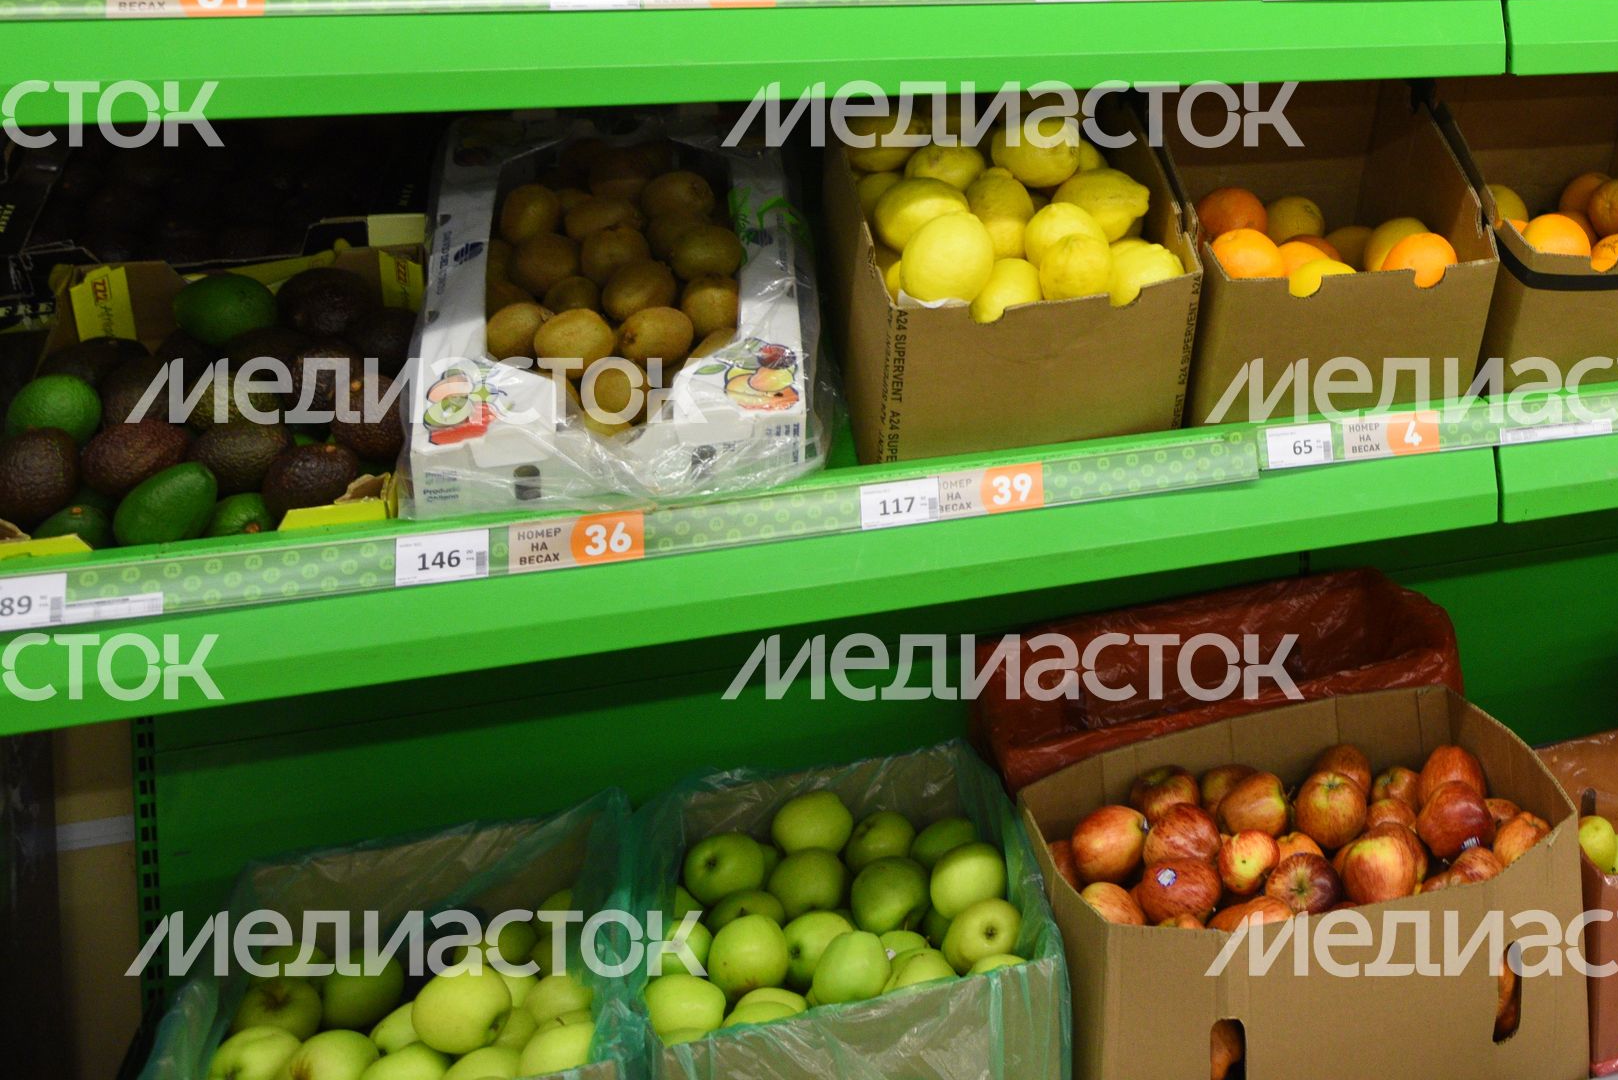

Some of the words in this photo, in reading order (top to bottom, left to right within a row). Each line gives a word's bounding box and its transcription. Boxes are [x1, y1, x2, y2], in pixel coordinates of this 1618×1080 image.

[897, 310, 909, 334] A24
[1181, 302, 1197, 365] SUPERVENT
[891, 334, 908, 403] SUPERVENT
[889, 410, 901, 431] A24
[1349, 423, 1380, 433] НОМЕР
[1359, 434, 1371, 442] НА
[1404, 420, 1422, 447] 4
[1292, 440, 1313, 456] 65
[1352, 444, 1380, 454] ВЕСАХ
[941, 478, 973, 490] ОМЕР
[992, 473, 1033, 505] 39
[947, 492, 962, 501] НА
[879, 496, 915, 516] 117
[517, 527, 562, 541] НОМЕР
[584, 522, 632, 556] 36
[531, 543, 548, 552] НА
[417, 549, 461, 572] 146
[519, 552, 560, 566] ВЕСАХ
